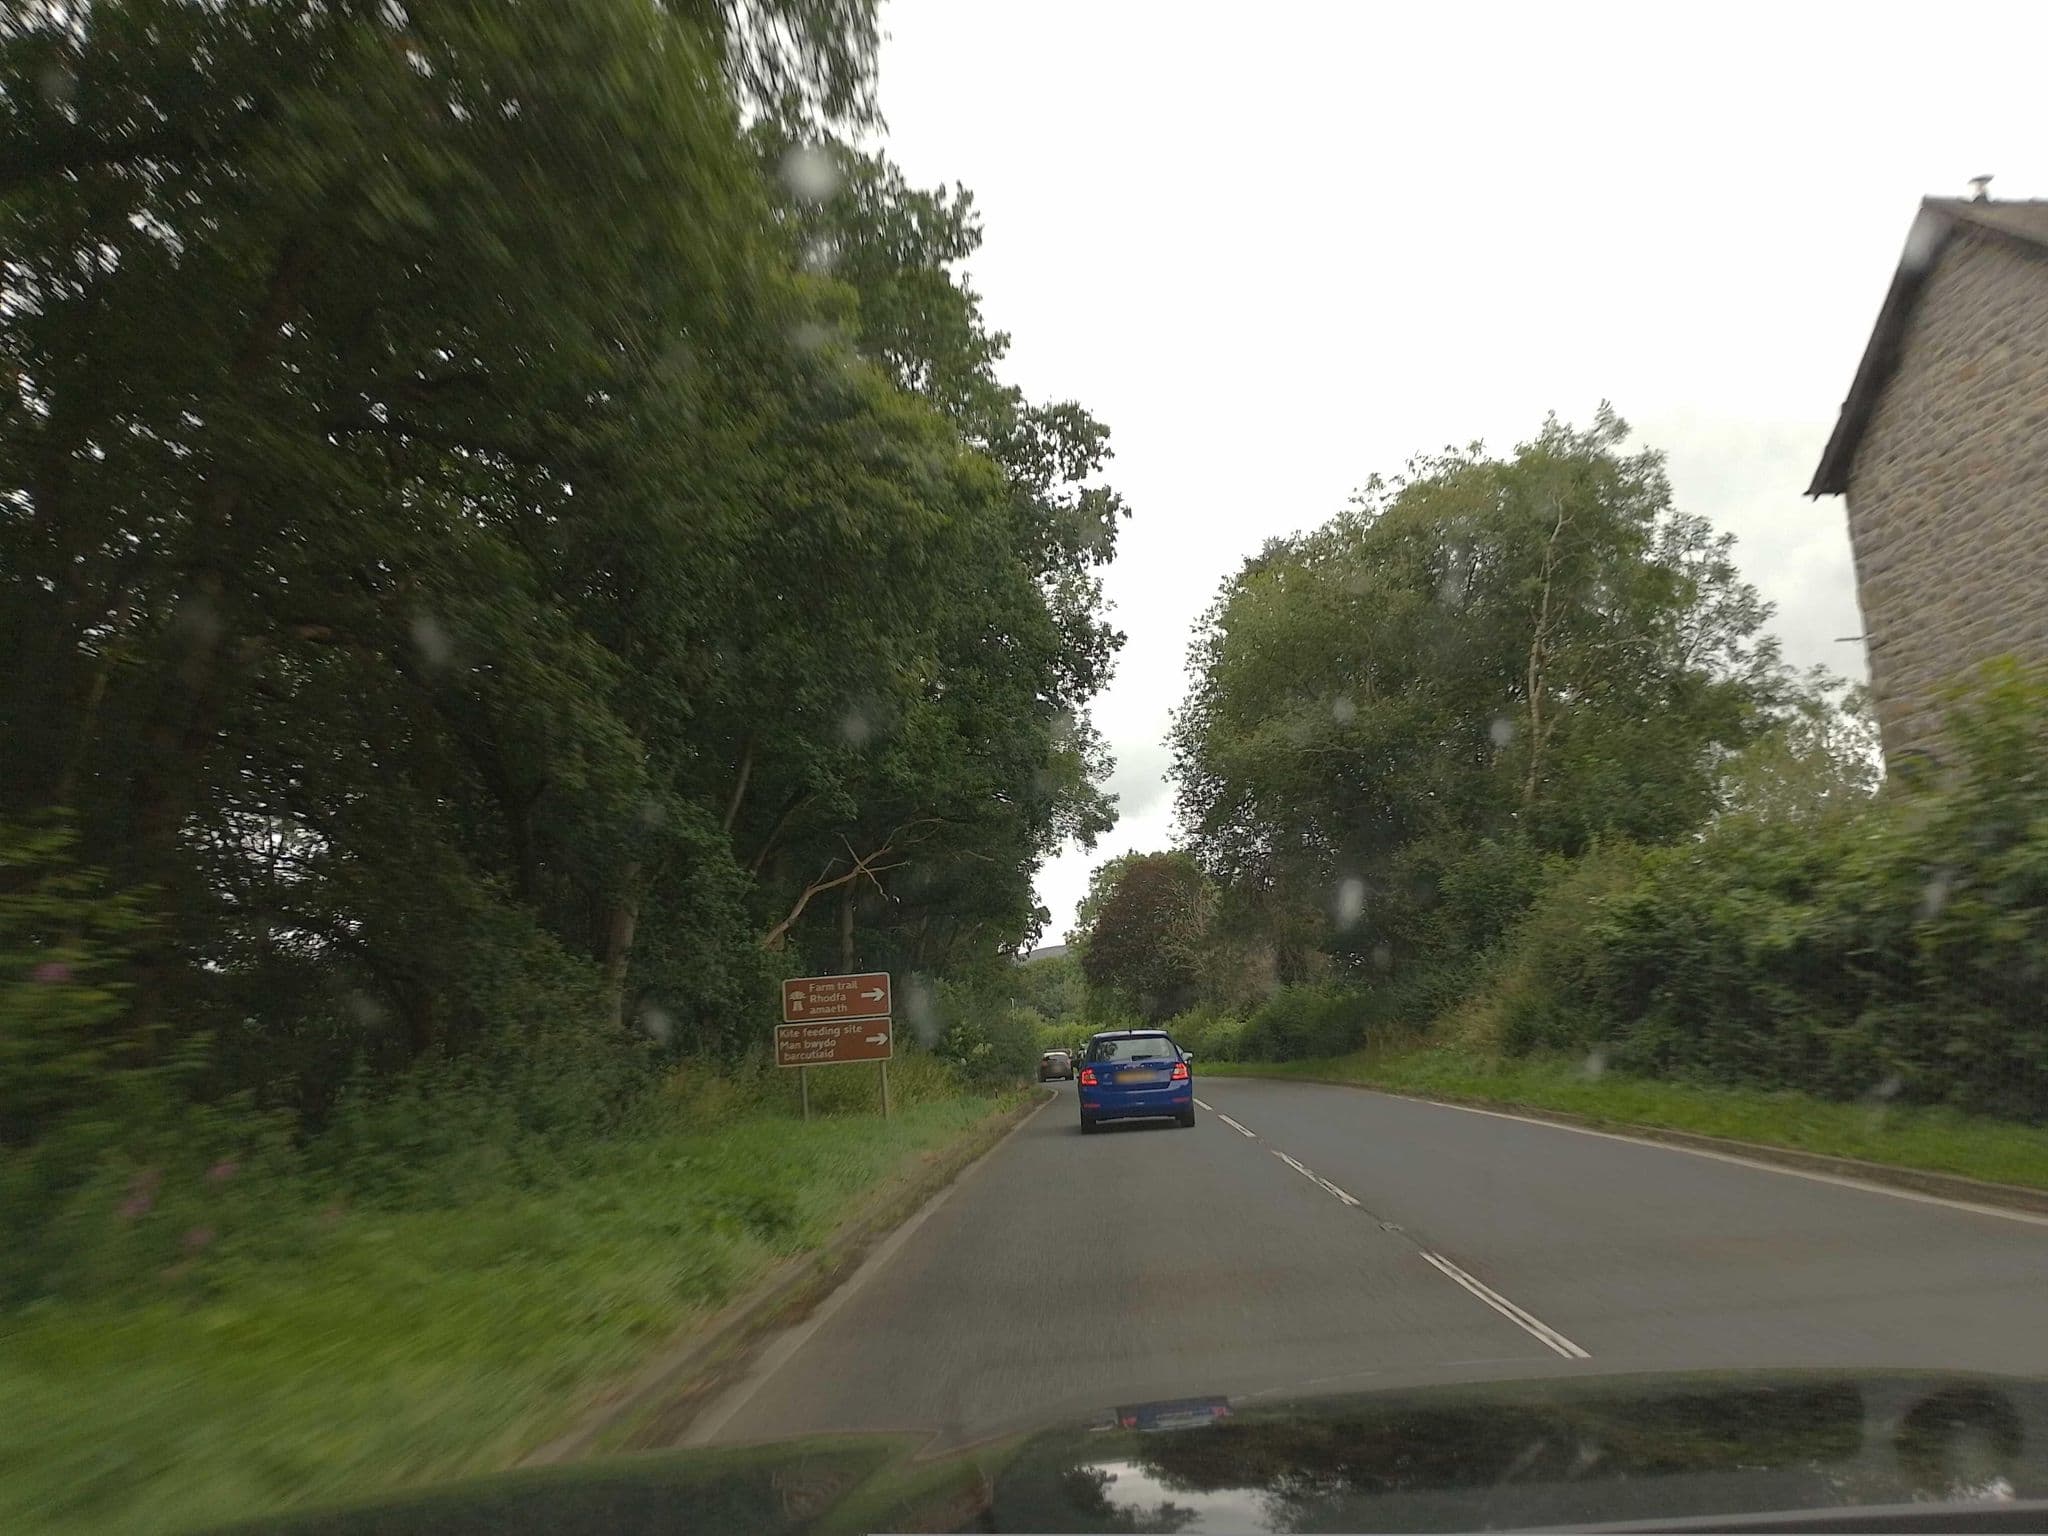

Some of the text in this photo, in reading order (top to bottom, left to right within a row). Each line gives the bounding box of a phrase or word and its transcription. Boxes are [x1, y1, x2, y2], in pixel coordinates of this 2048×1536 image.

[809, 981, 858, 992] Farm trail
[810, 993, 846, 1003] Rhodfa
[810, 1004, 847, 1014] amaeth
[779, 1024, 863, 1039] Kite feeding site
[780, 1039, 837, 1050] Man bwydo
